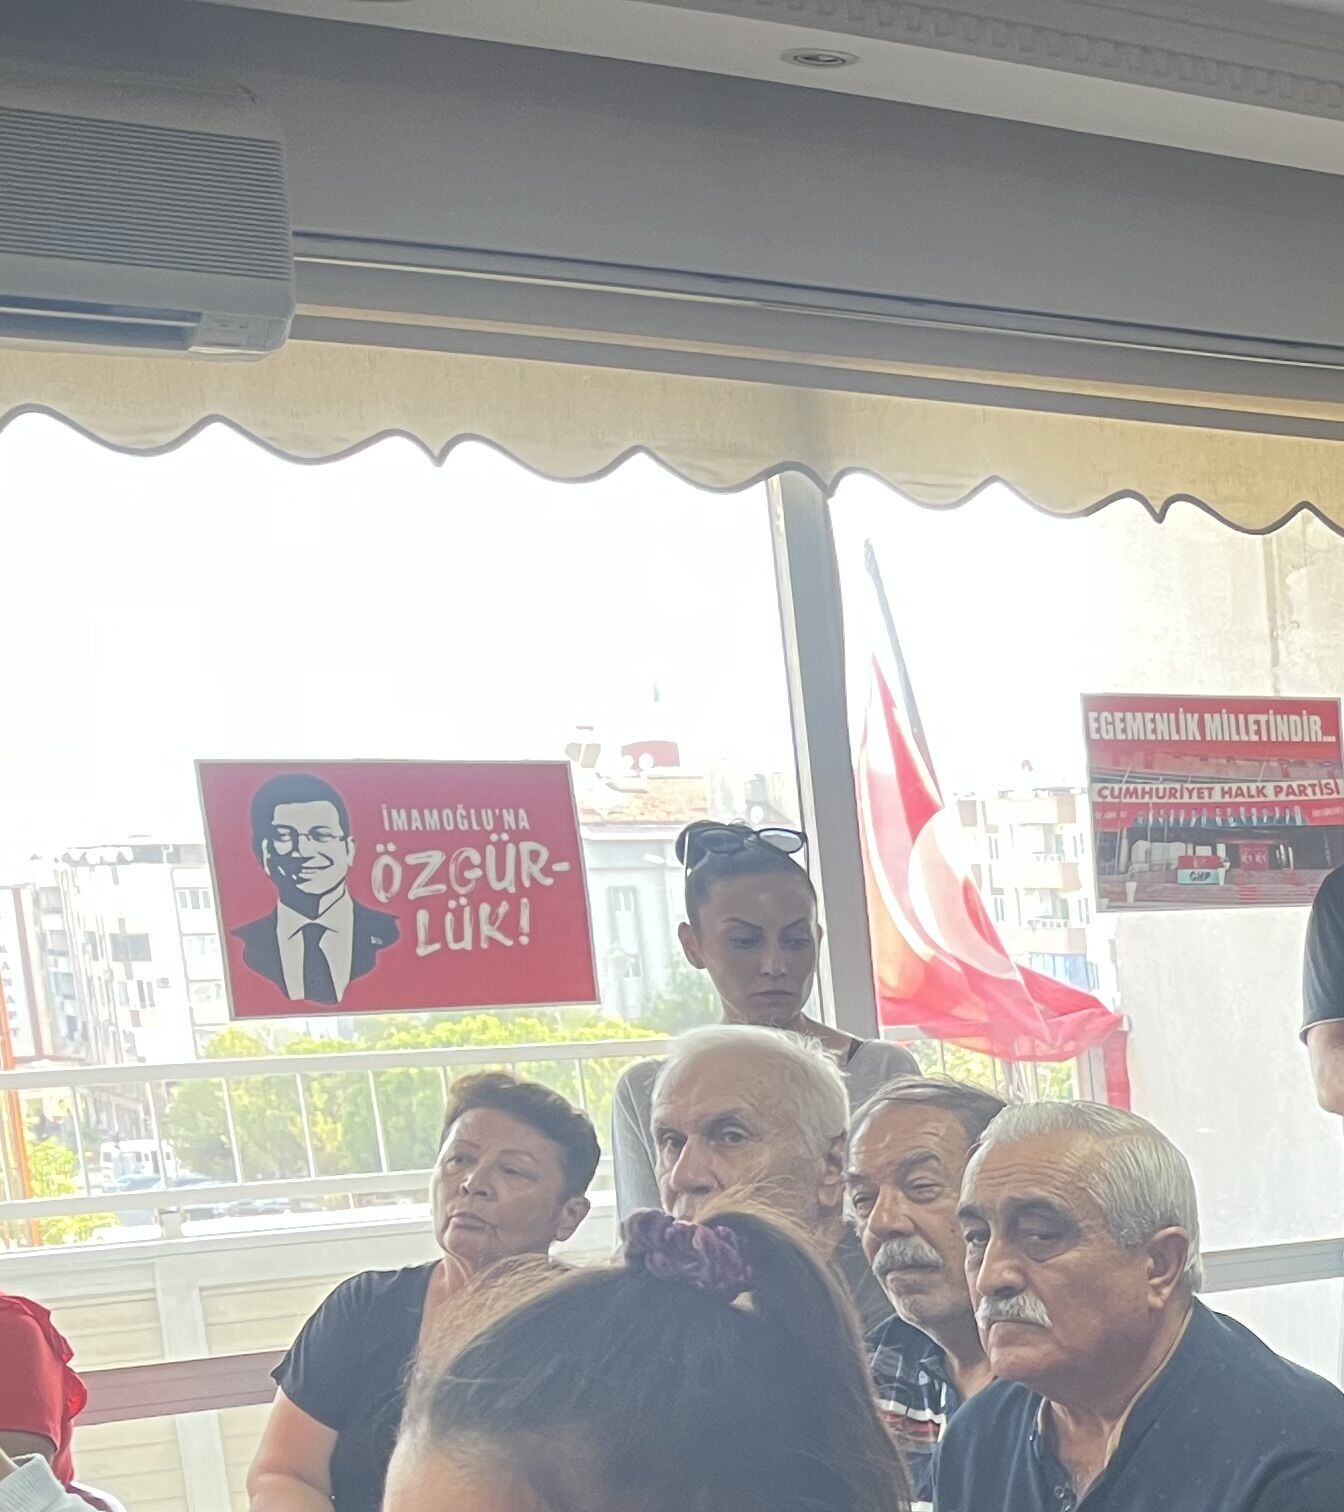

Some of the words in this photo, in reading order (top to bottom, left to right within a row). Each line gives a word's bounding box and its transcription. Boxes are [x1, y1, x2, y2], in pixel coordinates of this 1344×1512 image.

[1088, 708, 1201, 741] EGEMENLİK
[1097, 785, 1215, 801] CUMHURİYET
[1220, 784, 1267, 799] HALK
[1274, 779, 1341, 798] PARTİSİ
[381, 804, 530, 831] İMAMOĞLU'NA
[371, 832, 571, 903] ÖZGÜR-
[415, 897, 530, 957] LÜK!
